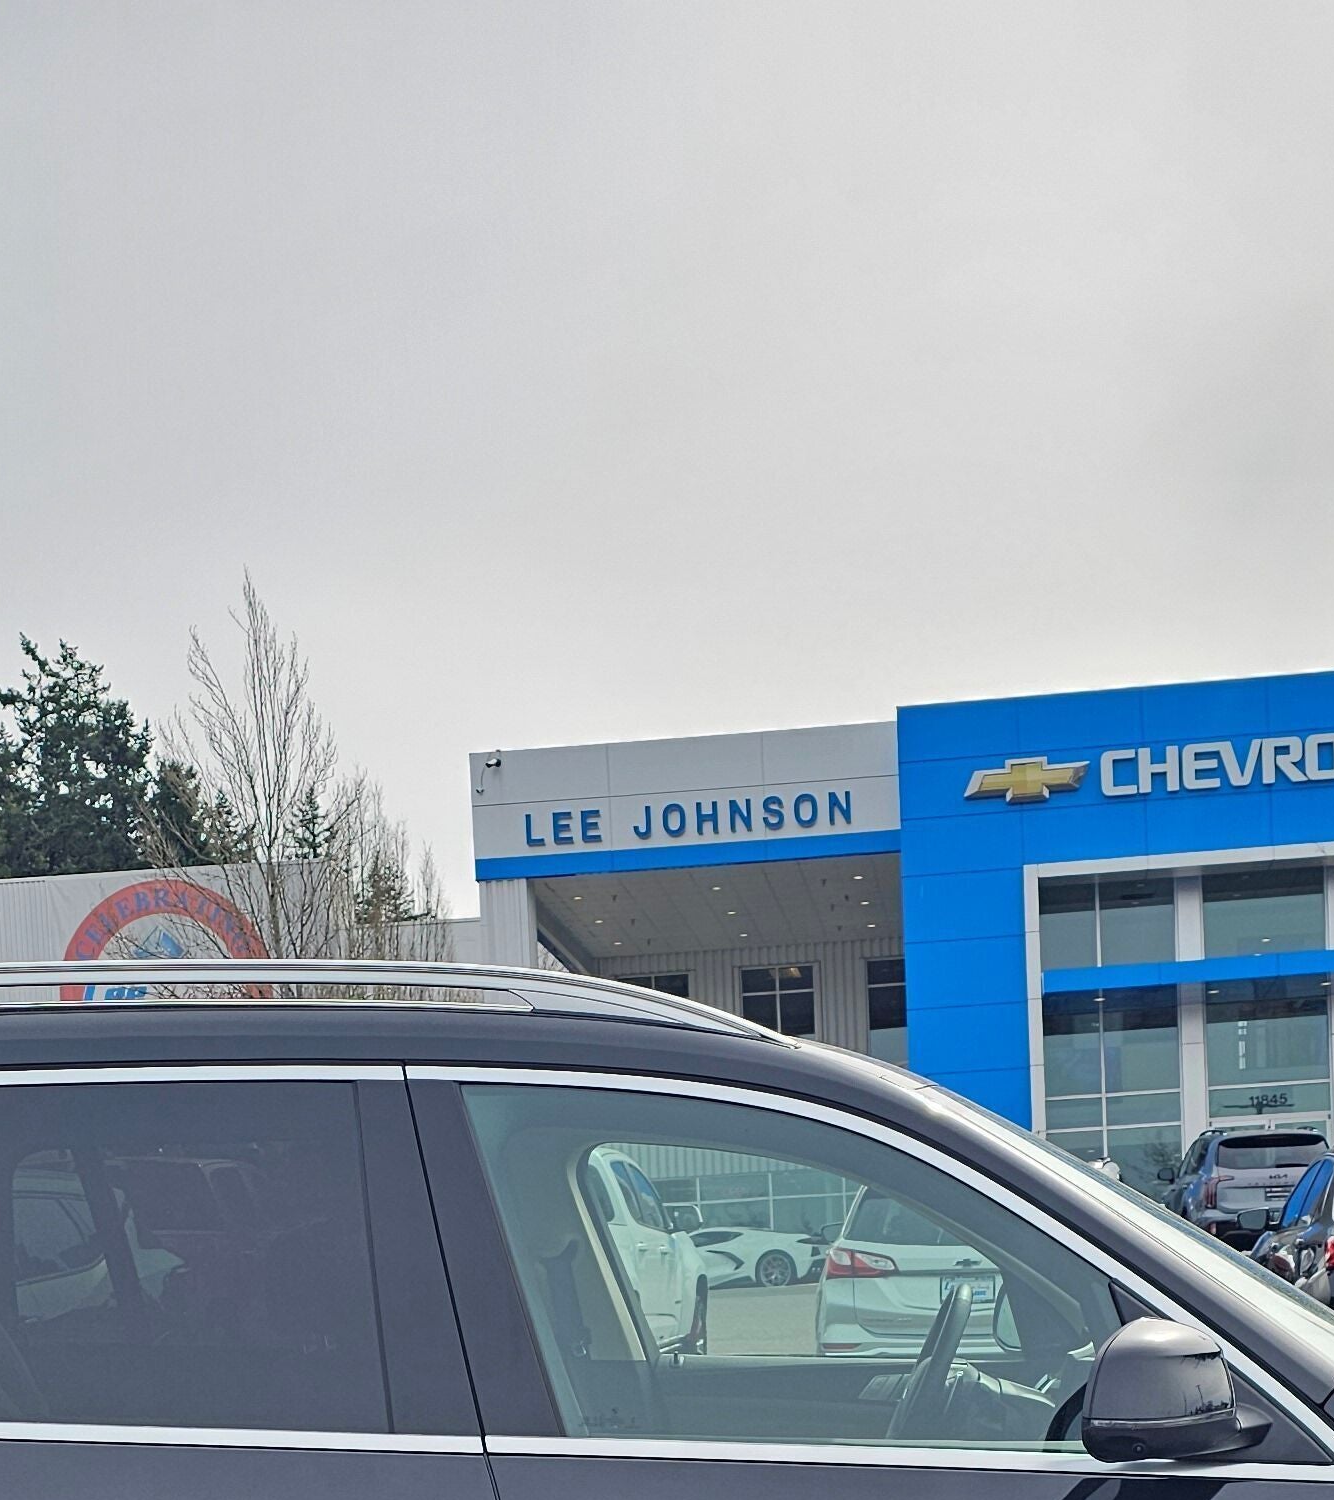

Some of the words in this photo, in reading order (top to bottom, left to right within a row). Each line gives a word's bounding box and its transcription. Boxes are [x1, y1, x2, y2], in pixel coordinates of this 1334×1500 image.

[525, 809, 603, 847] LEE
[633, 791, 853, 840] JOHNSON
[1249, 1093, 1288, 1105] 11845
